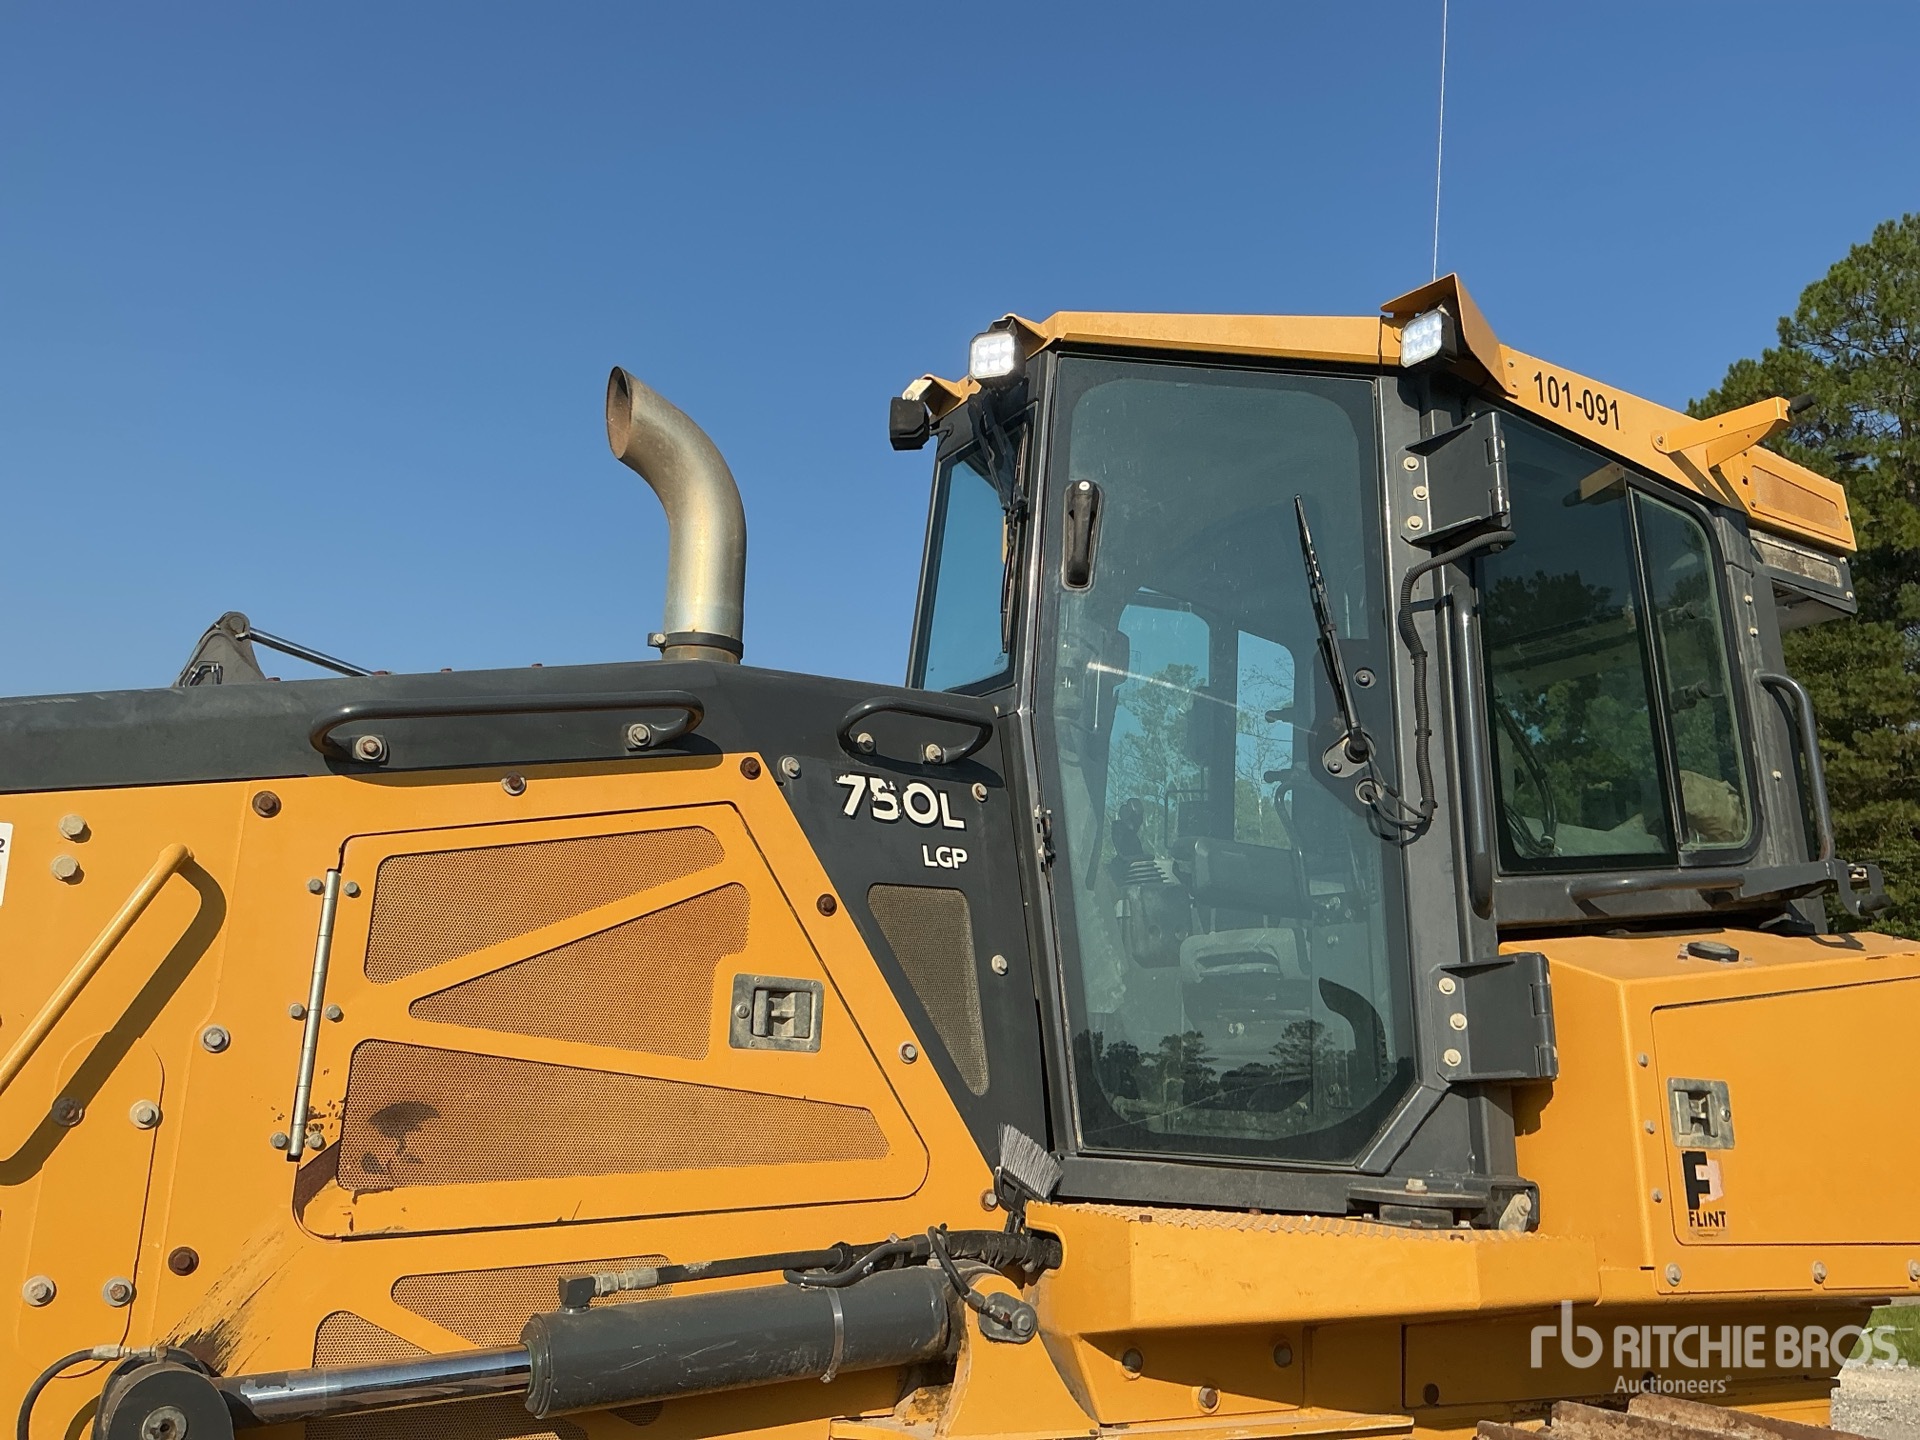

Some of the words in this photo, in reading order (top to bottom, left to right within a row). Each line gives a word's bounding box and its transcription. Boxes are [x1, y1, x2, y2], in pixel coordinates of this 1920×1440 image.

[1533, 371, 1620, 431] 101-091
[835, 773, 966, 830] 750L
[922, 844, 968, 869] LGP
[1688, 1210, 1726, 1228] FLINT
